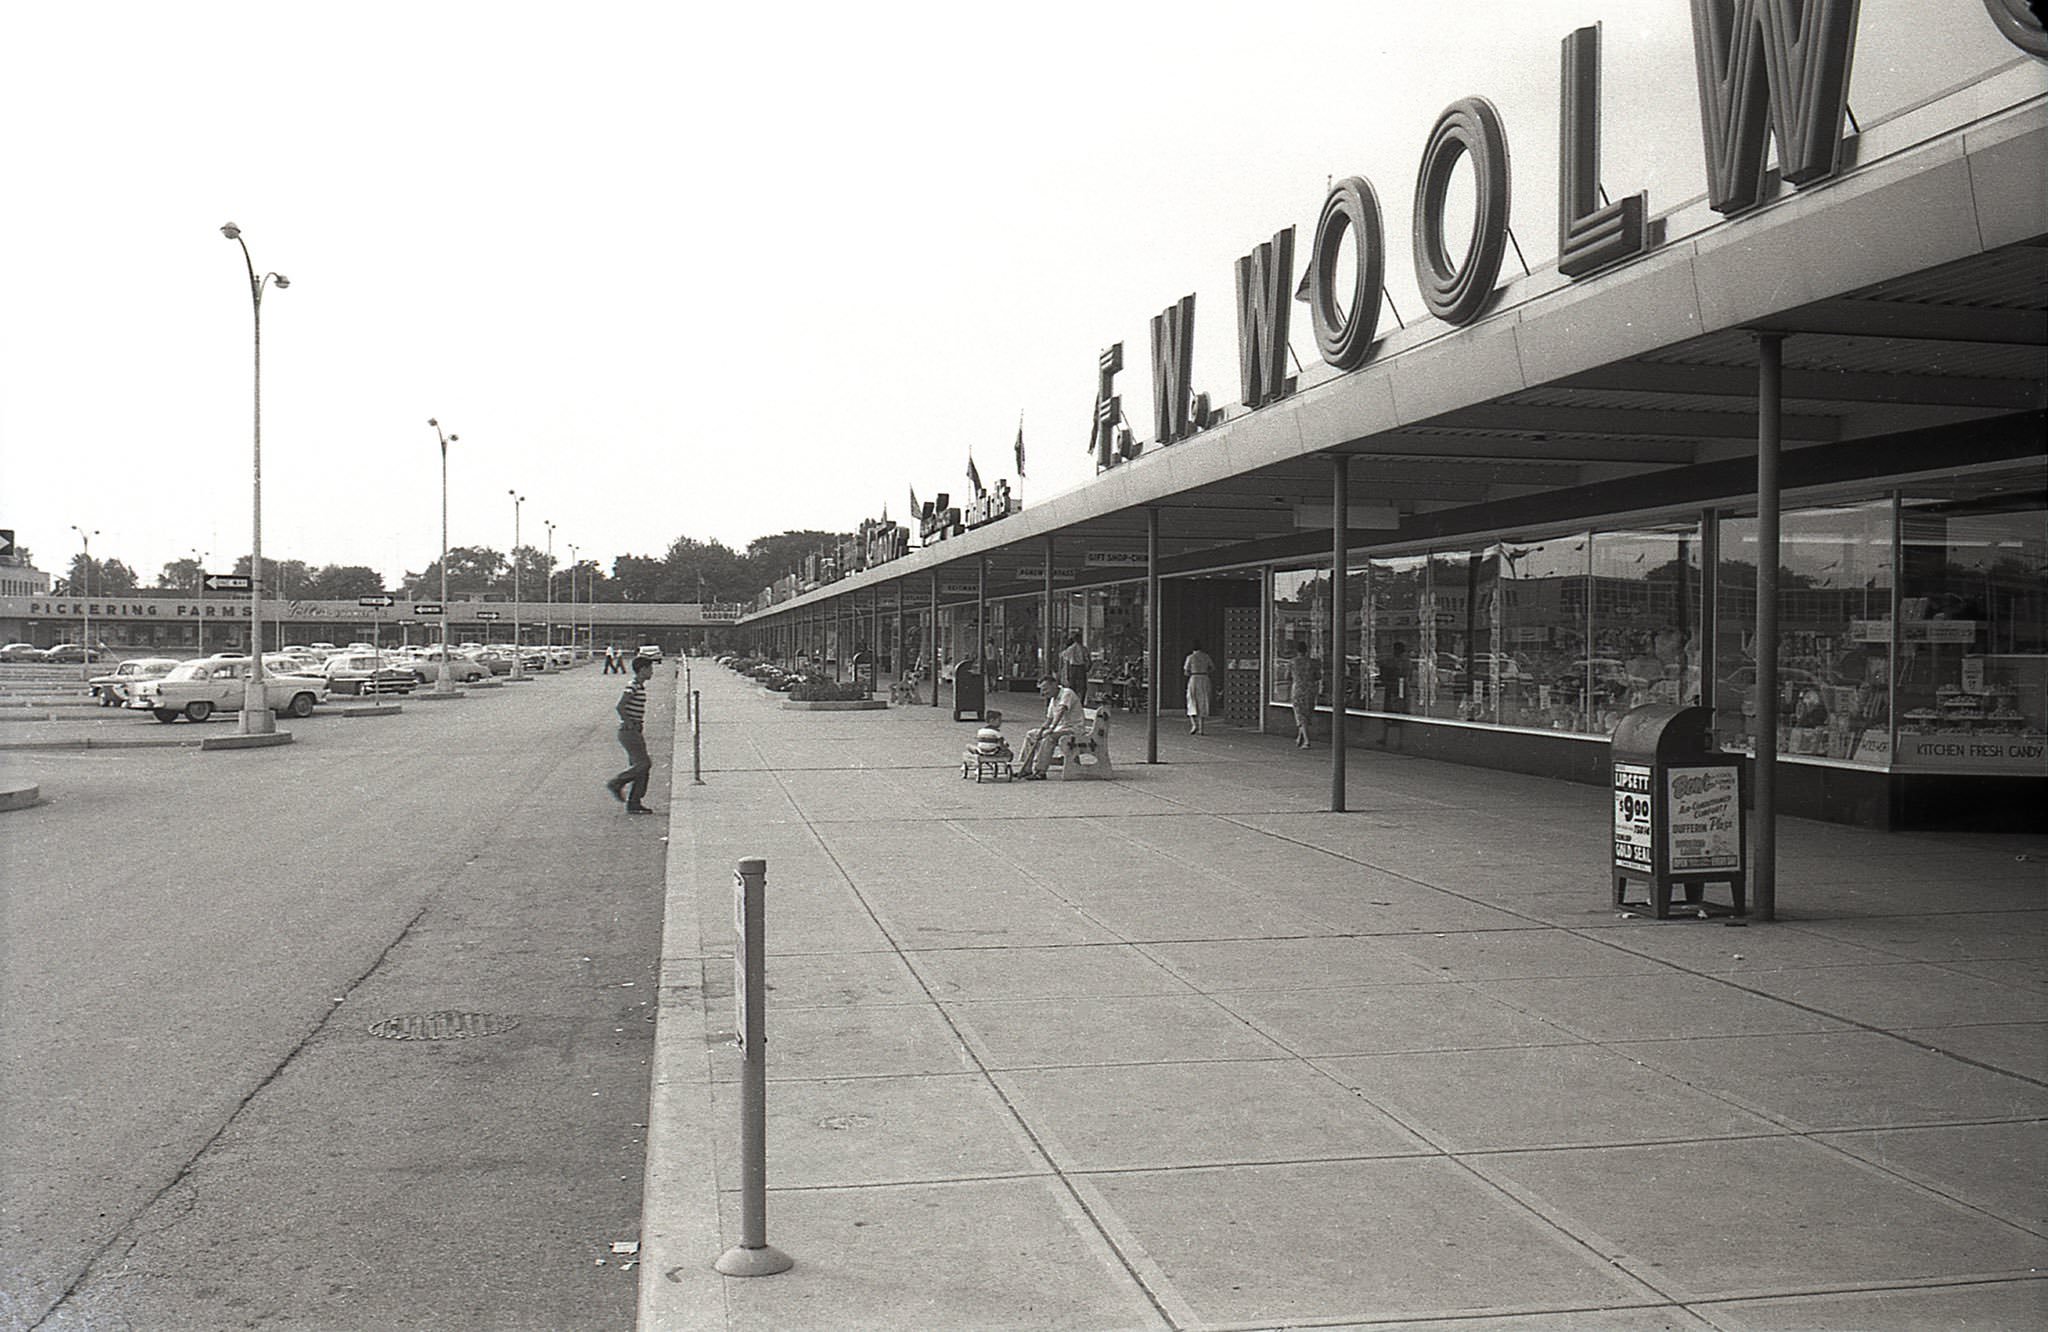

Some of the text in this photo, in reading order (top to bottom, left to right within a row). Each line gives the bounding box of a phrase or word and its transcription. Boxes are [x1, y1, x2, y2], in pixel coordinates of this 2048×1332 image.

[1234, 0, 2048, 412] WOOLW
[31, 603, 253, 617] PICKERING FARMS
[1917, 743, 2044, 759] KITCHEN FRESH CANDY
